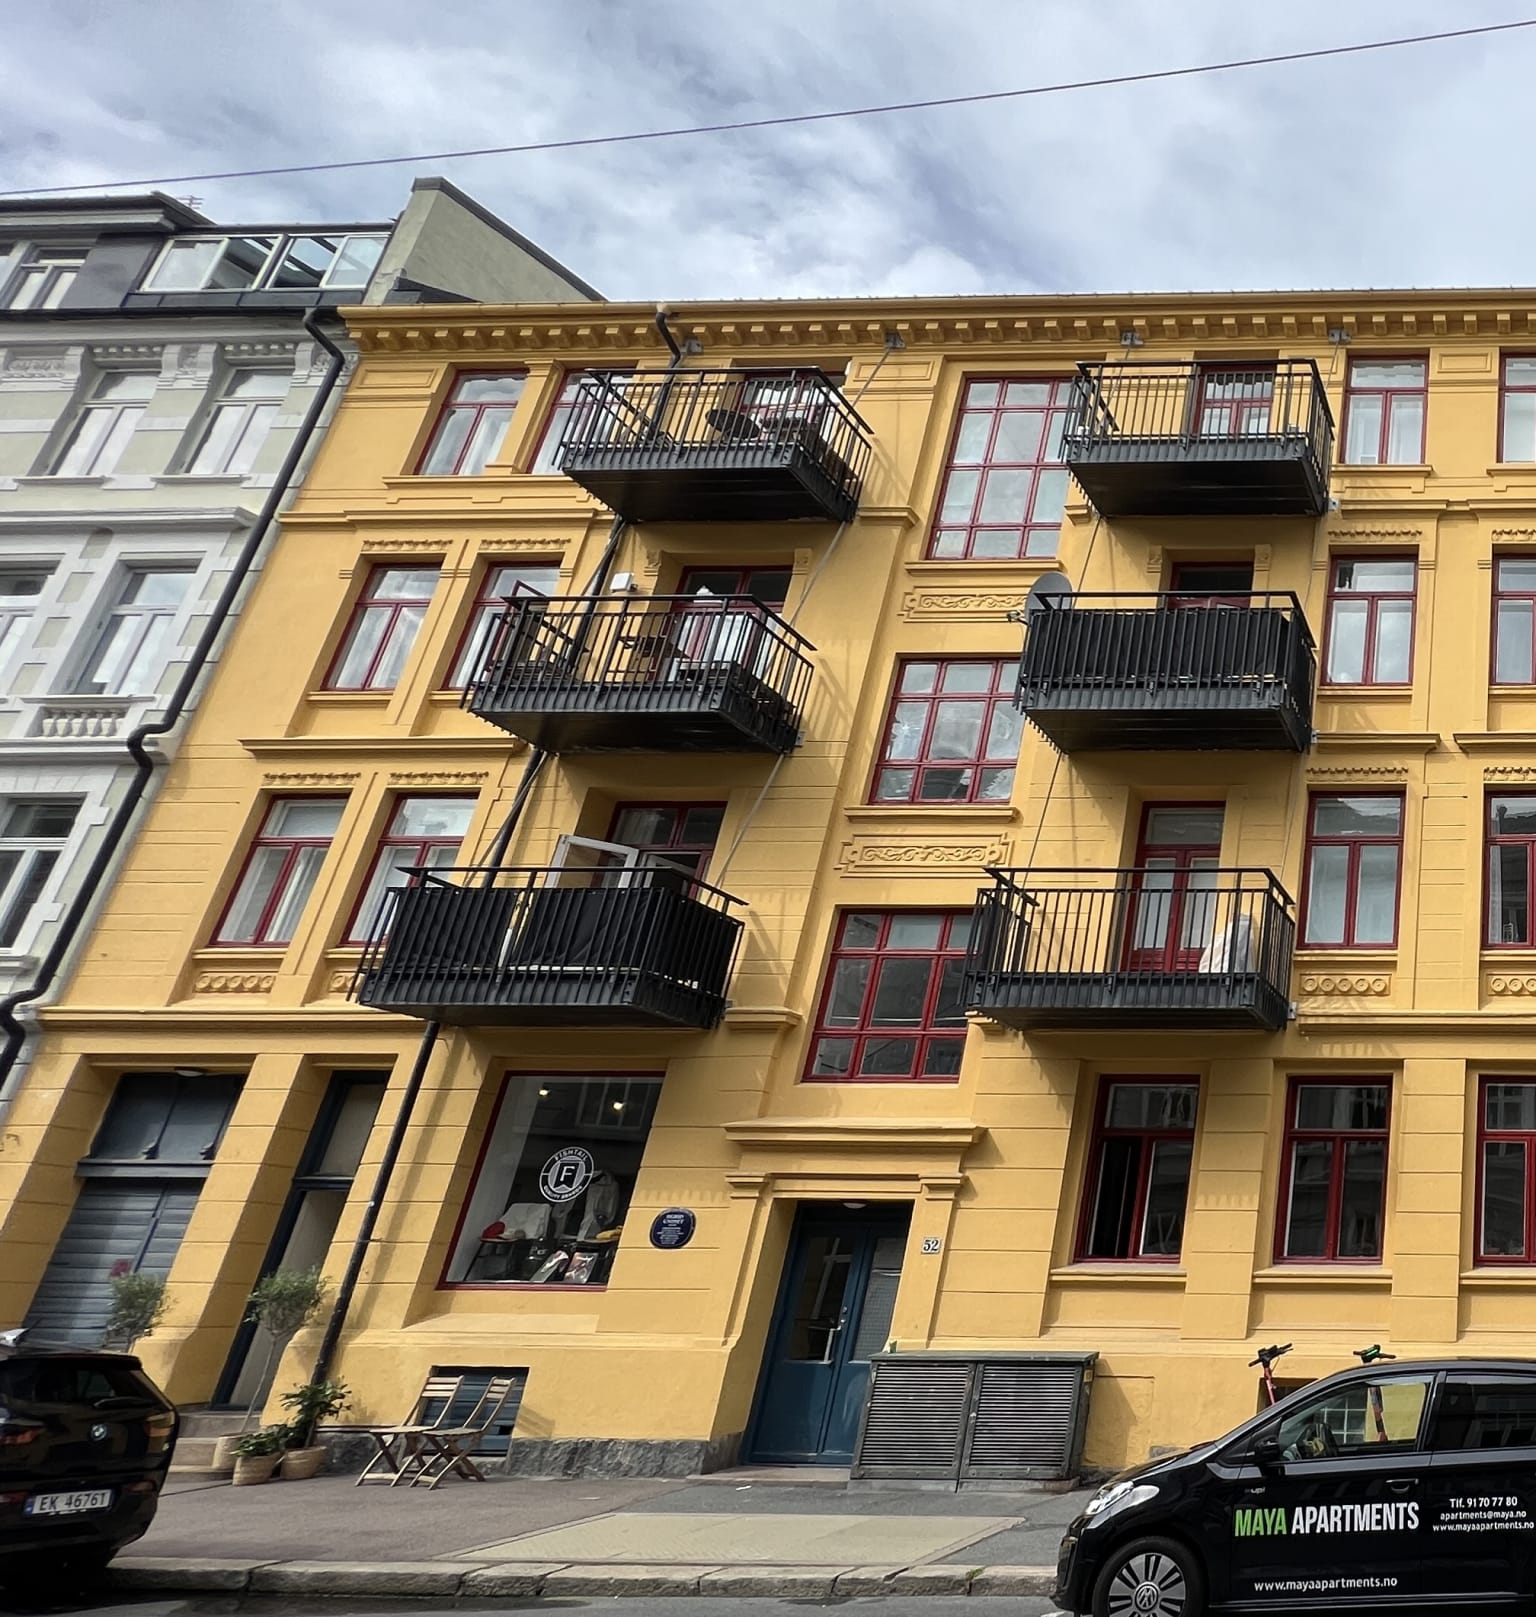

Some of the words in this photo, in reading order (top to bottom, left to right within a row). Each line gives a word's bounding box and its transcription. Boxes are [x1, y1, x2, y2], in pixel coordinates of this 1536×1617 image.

[560, 1165, 576, 1182] F
[923, 1239, 939, 1252] 52
[40, 1496, 58, 1511] EK
[1491, 1497, 1504, 1507] 77
[1505, 1496, 1518, 1506] 80
[1235, 1508, 1287, 1537] MAYA
[1291, 1501, 1420, 1535] APARTMENTS
[1440, 1510, 1527, 1522] apartments@maya.no
[1432, 1521, 1535, 1533] www.mayaapartments.no
[1254, 1576, 1398, 1592] www.mayaapartments.no
